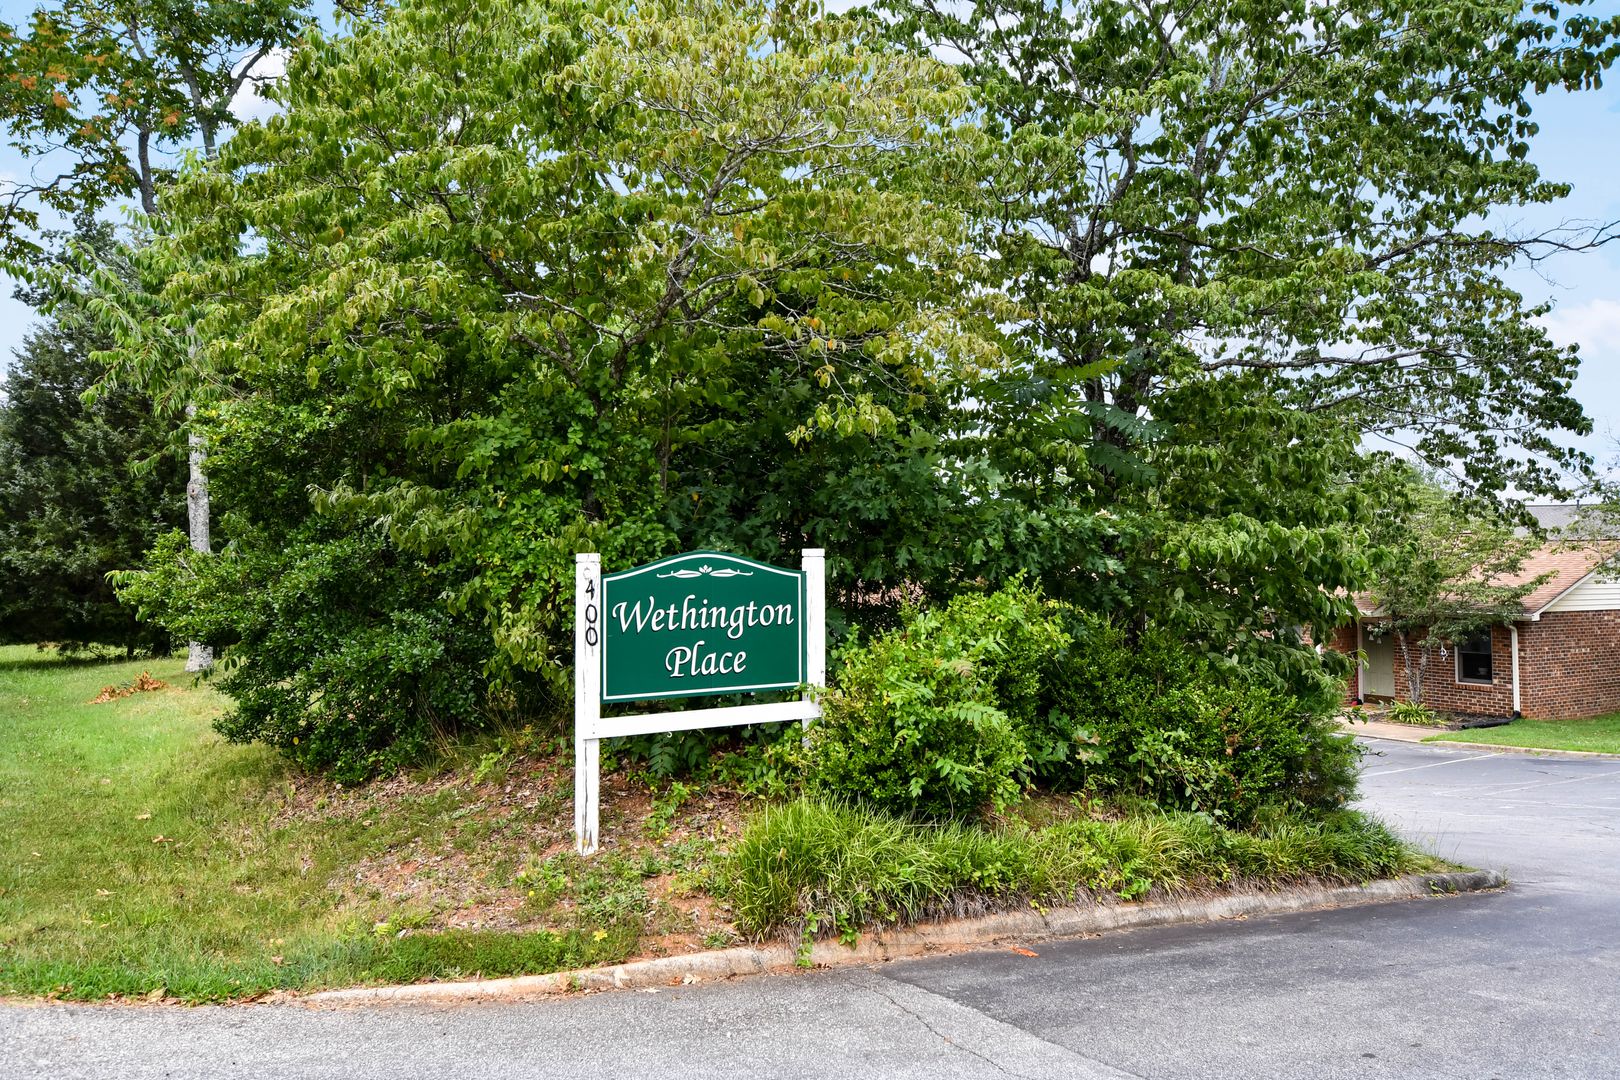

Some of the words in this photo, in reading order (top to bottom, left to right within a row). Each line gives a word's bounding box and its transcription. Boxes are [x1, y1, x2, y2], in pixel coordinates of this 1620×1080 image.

[585, 579, 599, 646] 400
[612, 594, 794, 640] Wethington
[665, 640, 747, 678] Place
